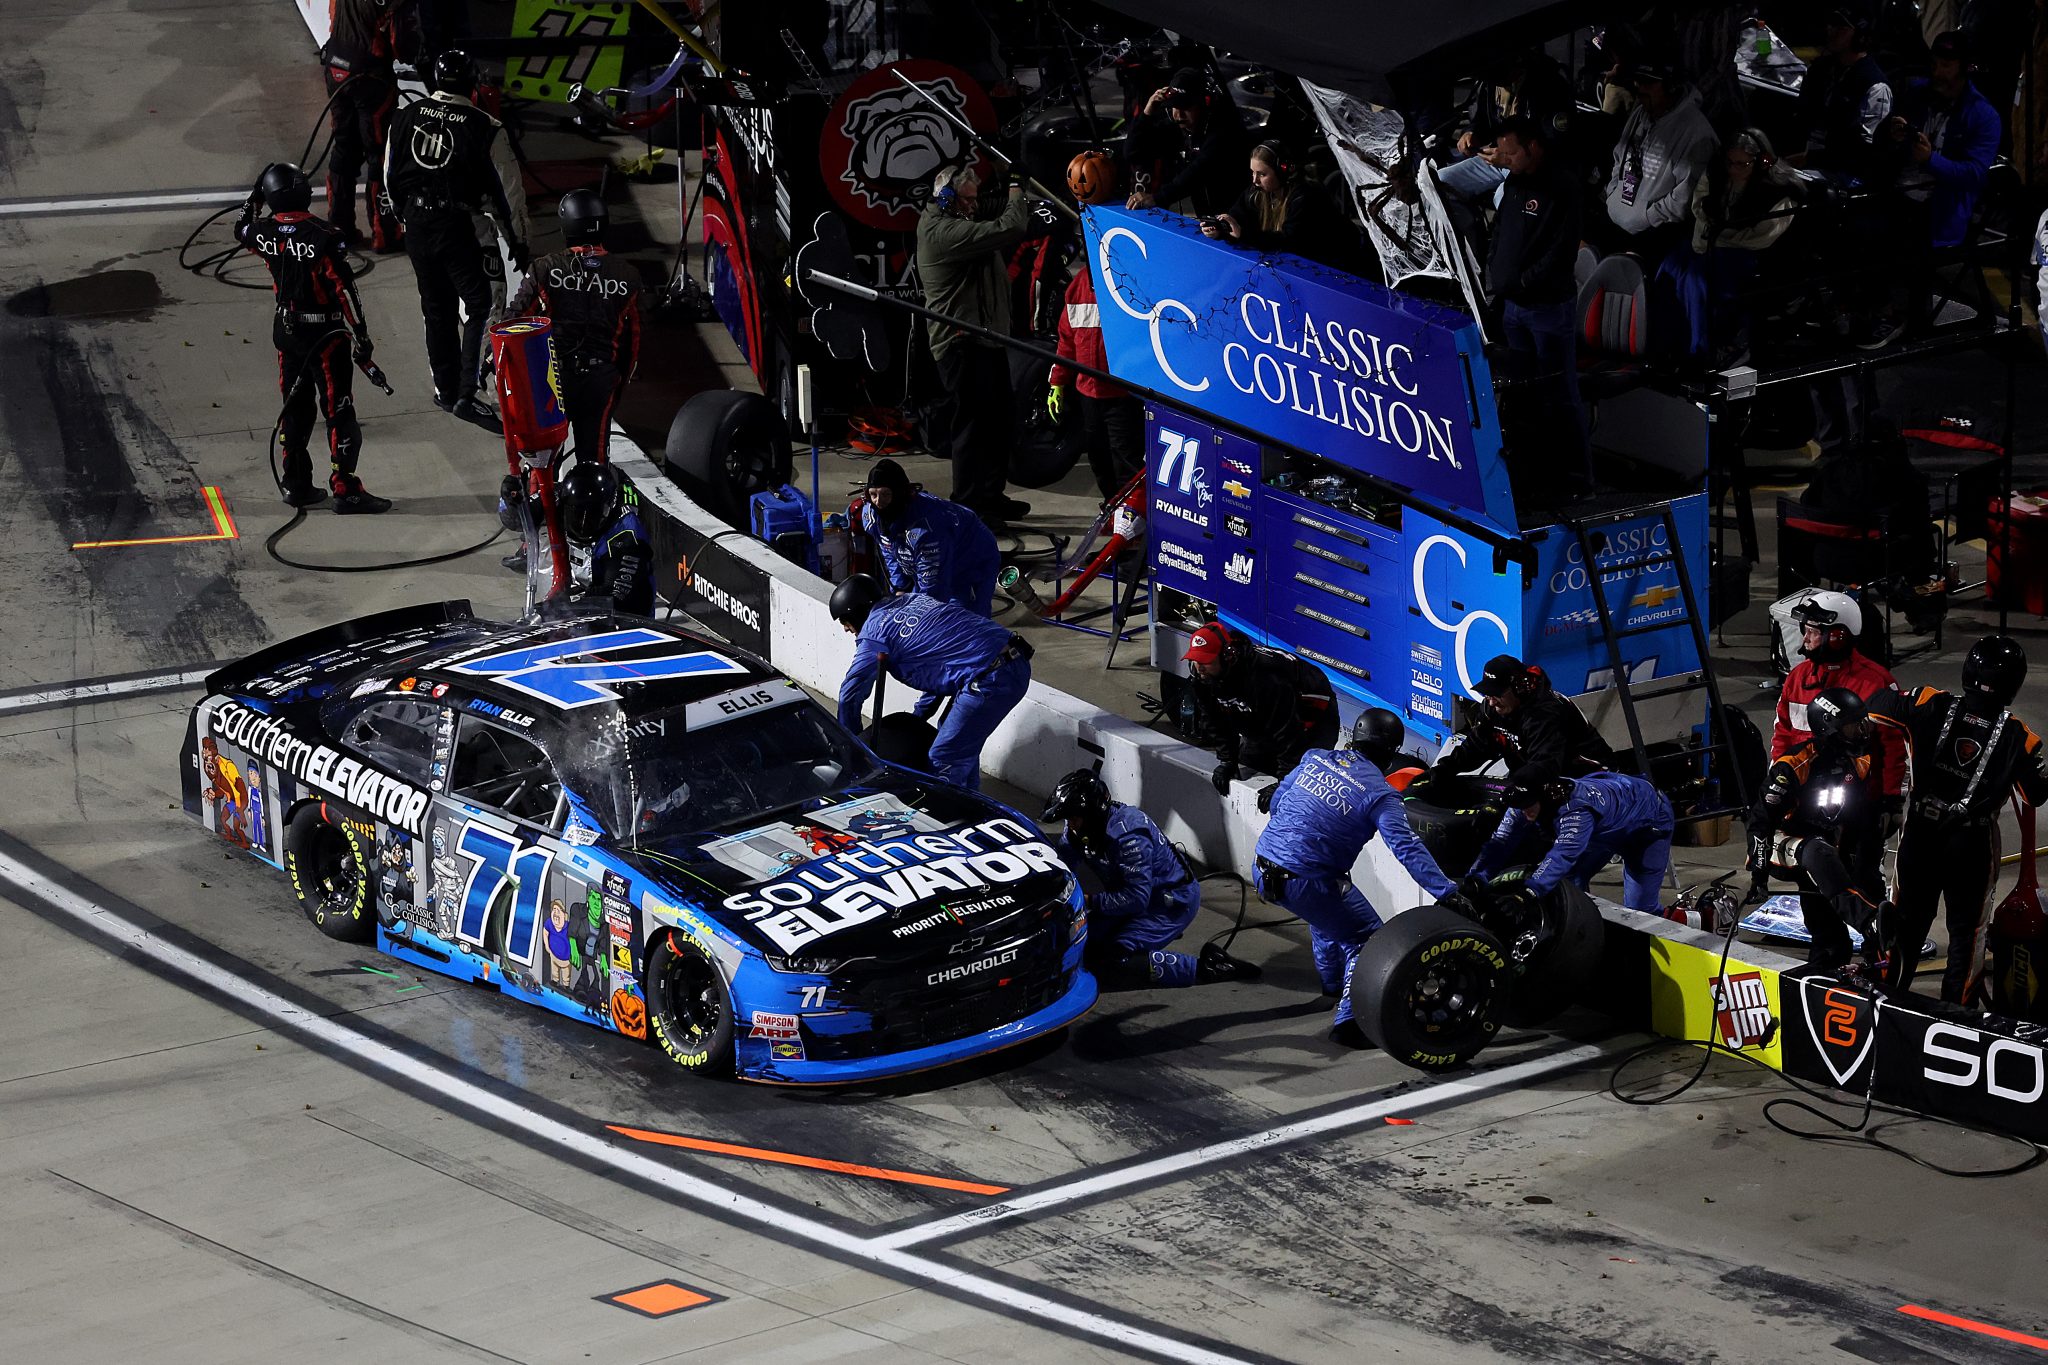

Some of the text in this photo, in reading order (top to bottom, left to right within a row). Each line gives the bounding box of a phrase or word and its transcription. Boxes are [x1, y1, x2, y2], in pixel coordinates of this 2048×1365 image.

[1240, 293, 1418, 395] CLASSIC
[1223, 342, 1457, 469] COLLISION
[1157, 427, 1200, 495] 71
[1156, 499, 1208, 527] RYAN ELLIS
[1227, 520, 1248, 536] xfinity
[1161, 541, 1205, 565] @DGMRacingFL
[1567, 523, 1668, 564] CASSIC
[1158, 553, 1207, 580] @RyanEllisRacing
[1551, 549, 1673, 594] COLISIO
[694, 572, 729, 616] RITCHIE
[1628, 608, 1683, 626] CHEVROLET
[1411, 650, 1442, 667] SWEETWATER
[1411, 668, 1443, 689] TABLO
[468, 699, 536, 727] RYAN ELLIS
[718, 690, 774, 715] ELLIS
[1411, 692, 1443, 711] southern
[1411, 701, 1443, 720] ELEVATOR
[1814, 696, 1841, 717] JGR
[213, 703, 428, 834] southern ELEVATOR
[1304, 763, 1351, 798] CLASSIC
[1296, 773, 1353, 815] OLLISION
[288, 851, 305, 900] EAGLE
[723, 818, 1035, 922] southern
[1488, 870, 1525, 887] EAGL
[454, 820, 556, 967] 71
[604, 897, 630, 914] COMETIC
[754, 841, 1066, 956] ELEVATOR
[402, 911, 439, 931] COLLISION
[406, 902, 434, 921] CLASSIC
[892, 895, 1016, 938] PRIORITY ELEVATOR
[682, 932, 712, 959] EAGLE
[927, 949, 1018, 986] CHEVROLET
[800, 985, 827, 1010] 71
[751, 1027, 799, 1038] ARP
[755, 1014, 795, 1028] SIMPSON
[1411, 1050, 1456, 1065] EAGLE
[1924, 1023, 2045, 1104] SO
